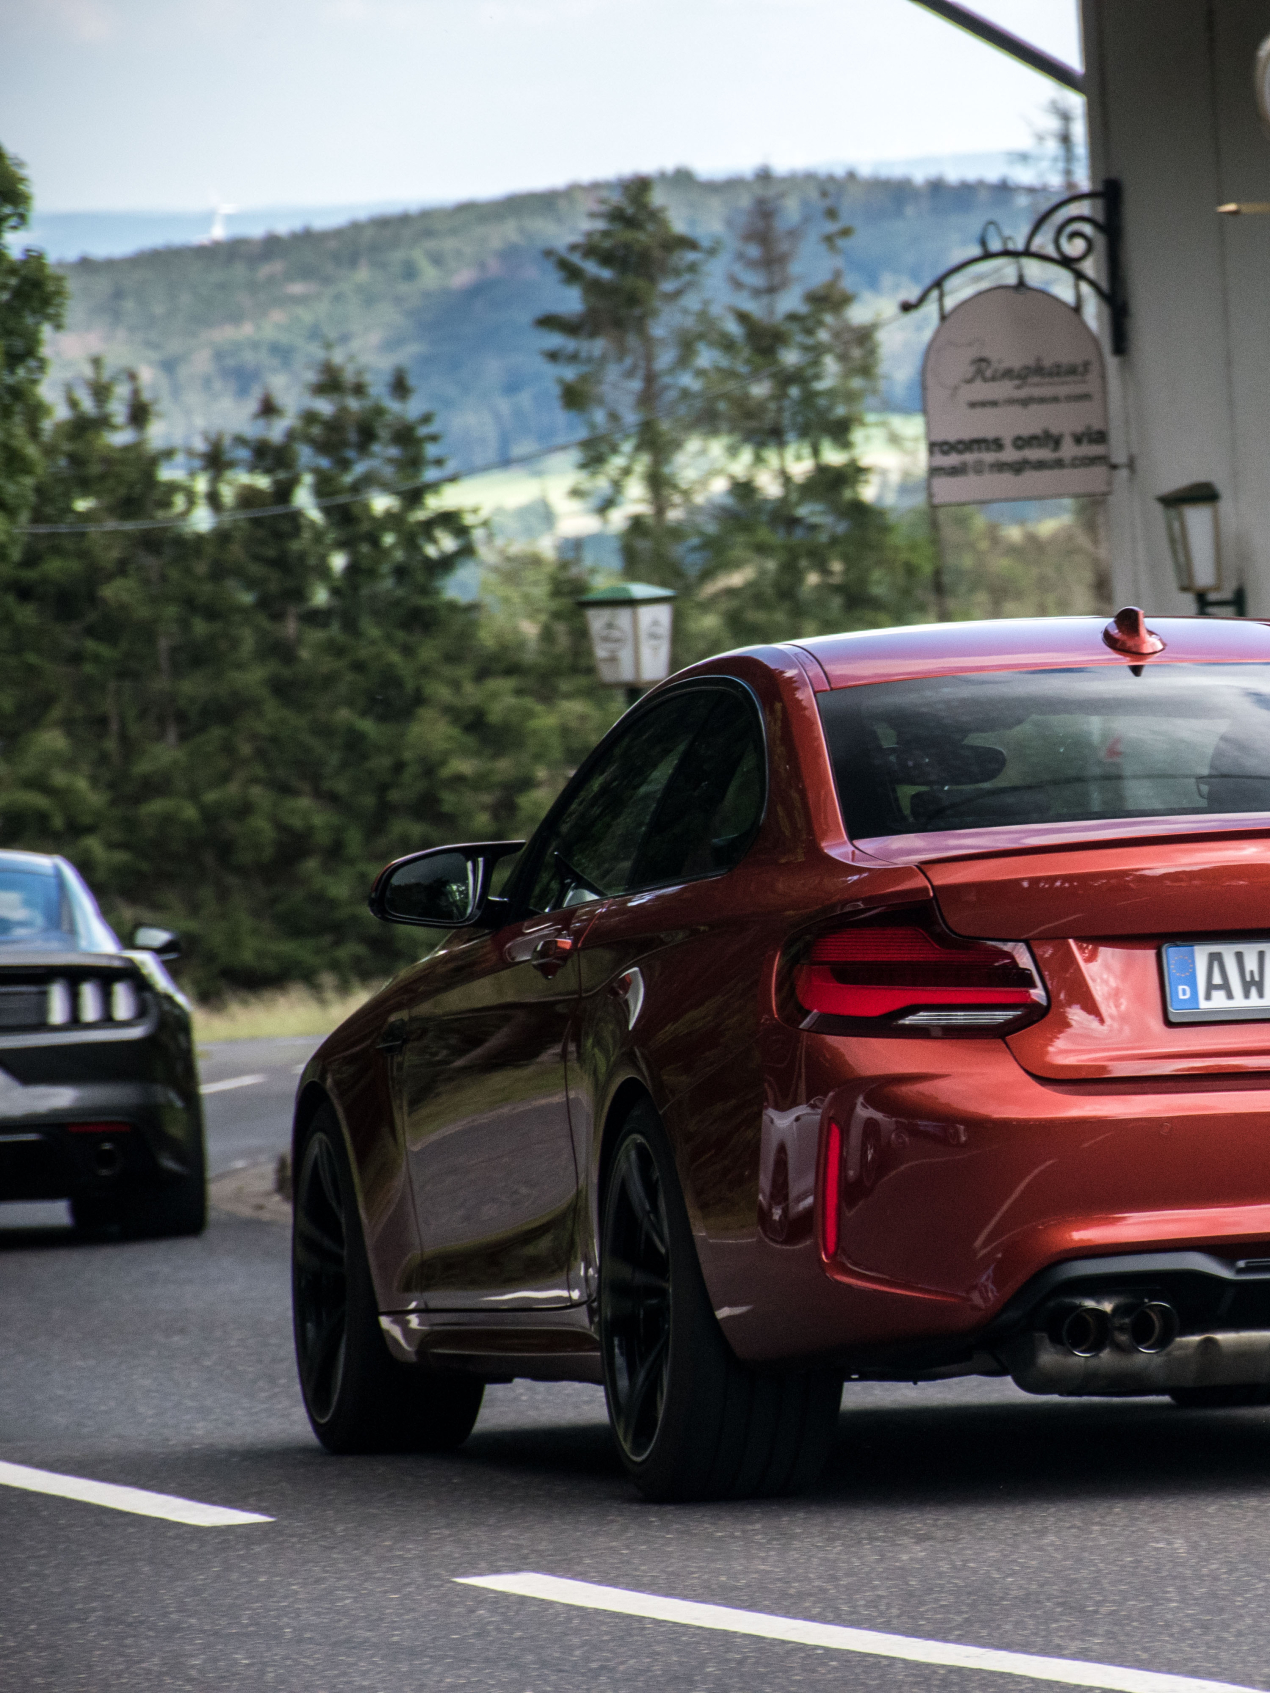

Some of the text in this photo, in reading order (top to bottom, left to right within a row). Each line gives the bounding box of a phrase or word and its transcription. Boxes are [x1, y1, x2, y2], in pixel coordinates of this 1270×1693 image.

[963, 356, 1092, 389] Ringhaus
[929, 425, 1107, 455] rooms only via
[1178, 985, 1191, 999] D
[1204, 950, 1266, 1001] AW
